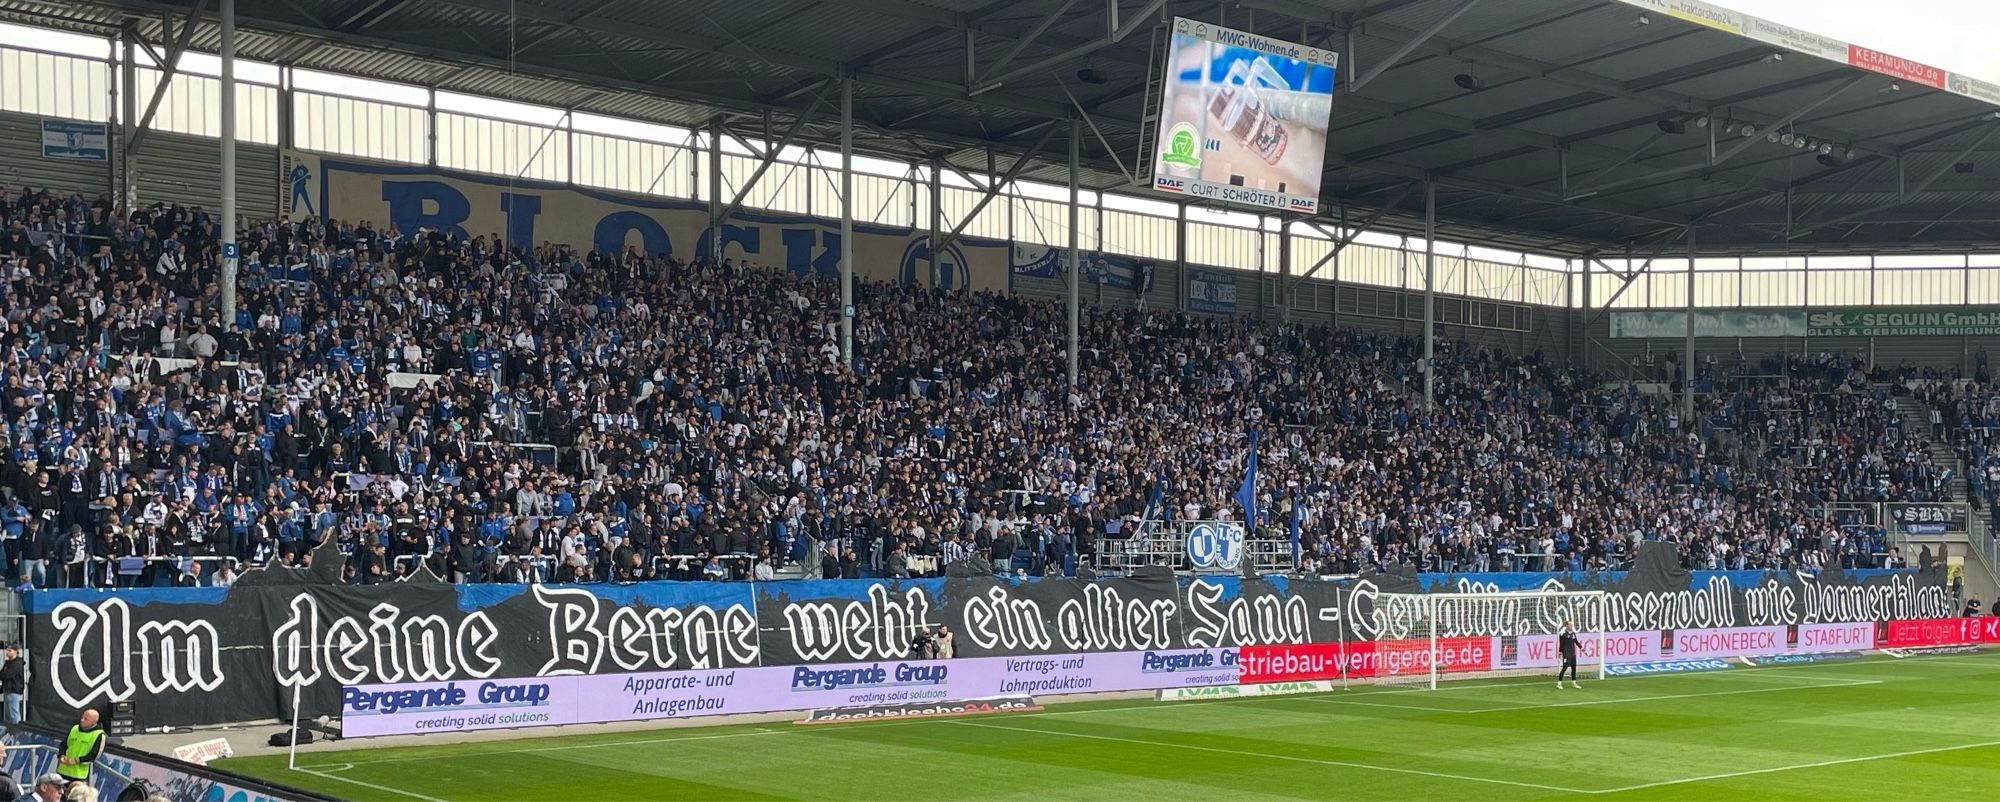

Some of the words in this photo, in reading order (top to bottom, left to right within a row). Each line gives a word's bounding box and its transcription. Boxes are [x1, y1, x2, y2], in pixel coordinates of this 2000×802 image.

[1216, 29, 1300, 59] MWG-Wohnen.de
[1157, 178, 1185, 188] DAF
[1191, 183, 1219, 197] CURT
[1222, 186, 1275, 206] SCHRÖTER
[1290, 198, 1315, 208] DAF
[227, 245, 235, 255] 3
[1614, 314, 1658, 329] SWM
[1745, 313, 1790, 329] SWM
[1862, 312, 1940, 326] SEGUIN
[1808, 328, 1847, 336] GLAS-
[1848, 328, 1857, 336] &
[1680, 630, 1776, 653] SCHÖNEBECK
[1892, 622, 1919, 641] Jetzt
[1922, 622, 1956, 644] folgen
[51, 597, 225, 709] Um
[272, 592, 501, 687] deine
[532, 583, 759, 676] Berge
[783, 582, 928, 661] weht
[963, 585, 1051, 650] ein
[1058, 583, 1176, 650] alter
[1188, 579, 1311, 647] Sang
[1745, 578, 1798, 625] wie
[1006, 658, 1058, 675] Vertrags-
[1062, 656, 1085, 670] und
[1142, 650, 1214, 673] Pergande
[1239, 645, 1484, 676] striebau-wernigerode.de
[623, 676, 701, 695] Apparate-
[706, 671, 735, 687] und
[792, 663, 886, 690] Pergande
[895, 662, 948, 685] Group
[1000, 676, 1092, 694] Lohnproduktion
[1185, 674, 1213, 684] creating
[1214, 673, 1231, 682] solid
[342, 682, 466, 715] Pergande
[478, 681, 550, 706] Group
[633, 695, 725, 716] Anlagenbau
[849, 692, 886, 704] creating
[887, 690, 909, 701] solid
[910, 689, 947, 699] solutions
[415, 717, 465, 730] creating
[467, 713, 496, 725] solid
[498, 711, 550, 723] solutions
